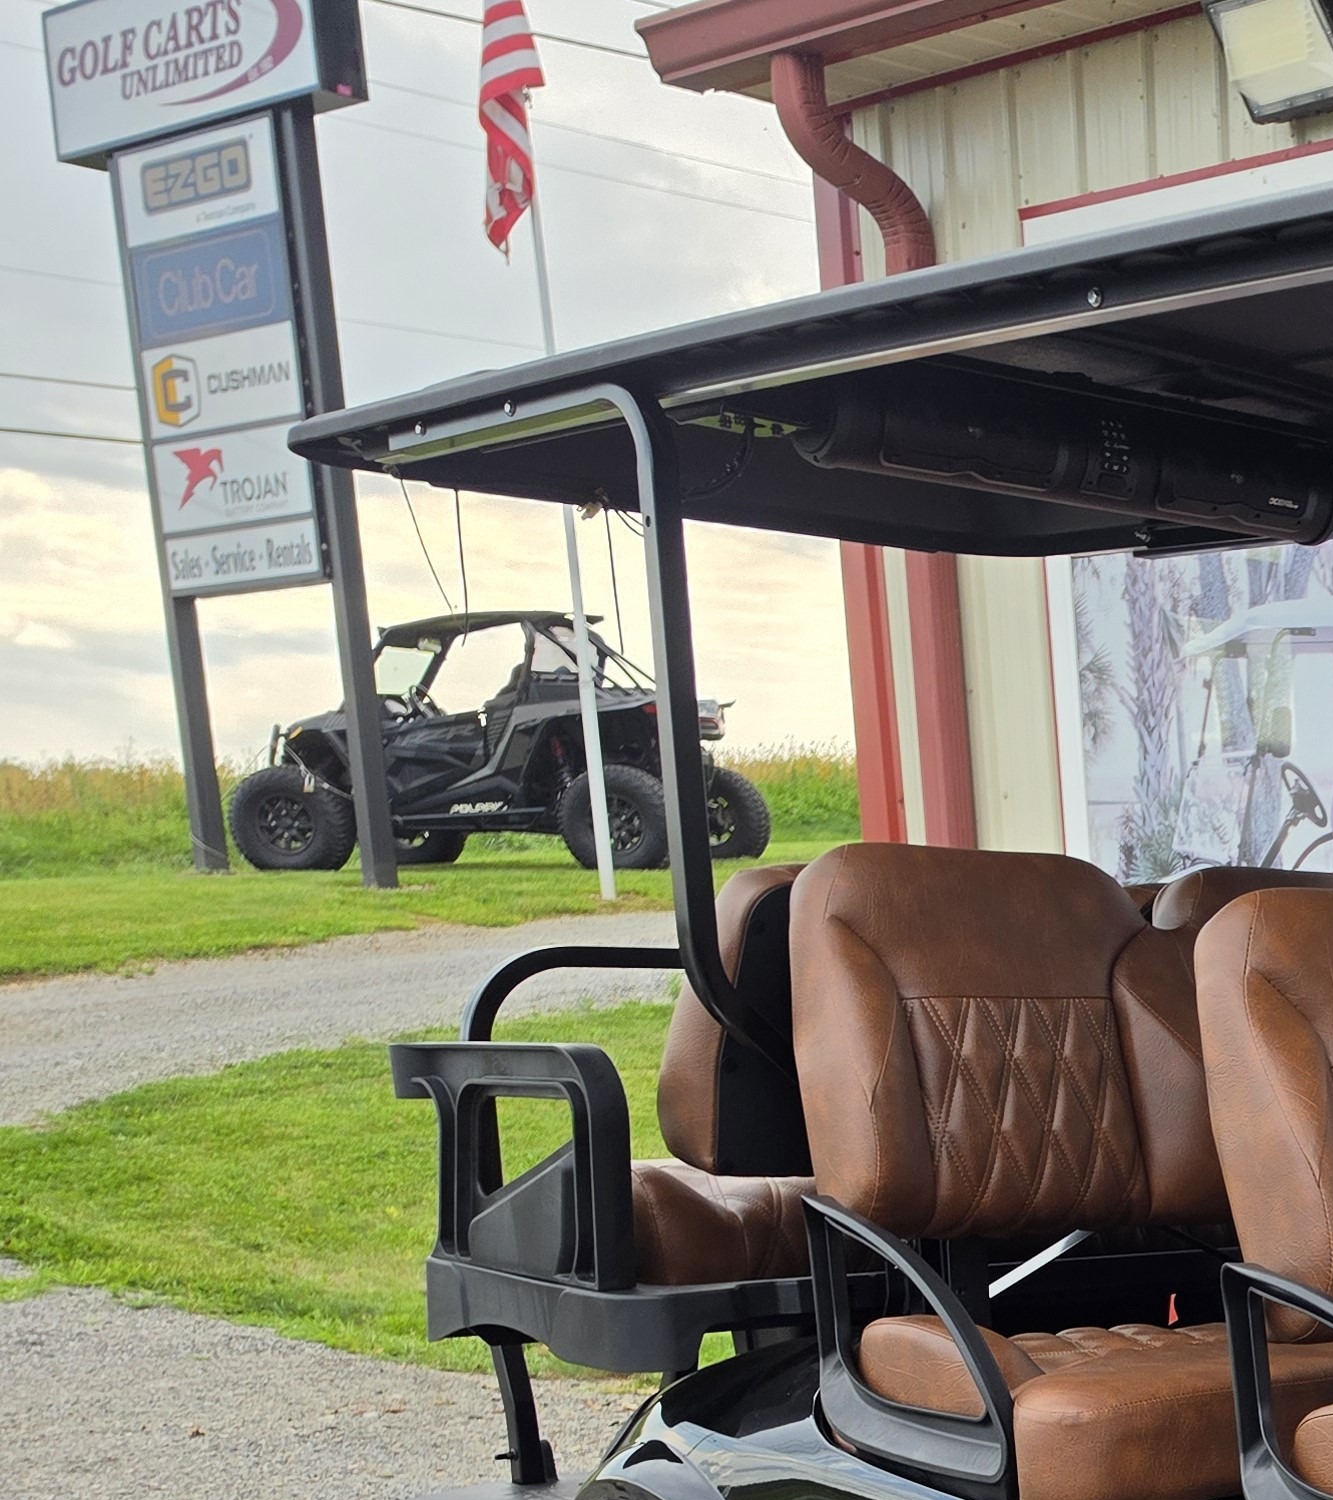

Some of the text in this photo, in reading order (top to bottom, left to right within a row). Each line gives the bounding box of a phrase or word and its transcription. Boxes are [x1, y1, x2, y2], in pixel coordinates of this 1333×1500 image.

[58, 0, 241, 87] GOLF CARTS
[121, 40, 243, 100] UNLIMITED
[143, 144, 249, 209] EZGO
[158, 257, 259, 317] Club Car
[207, 361, 290, 395] CUSHMAN
[220, 471, 289, 505] TROJAN
[171, 533, 313, 580] Sales Service Rentals
